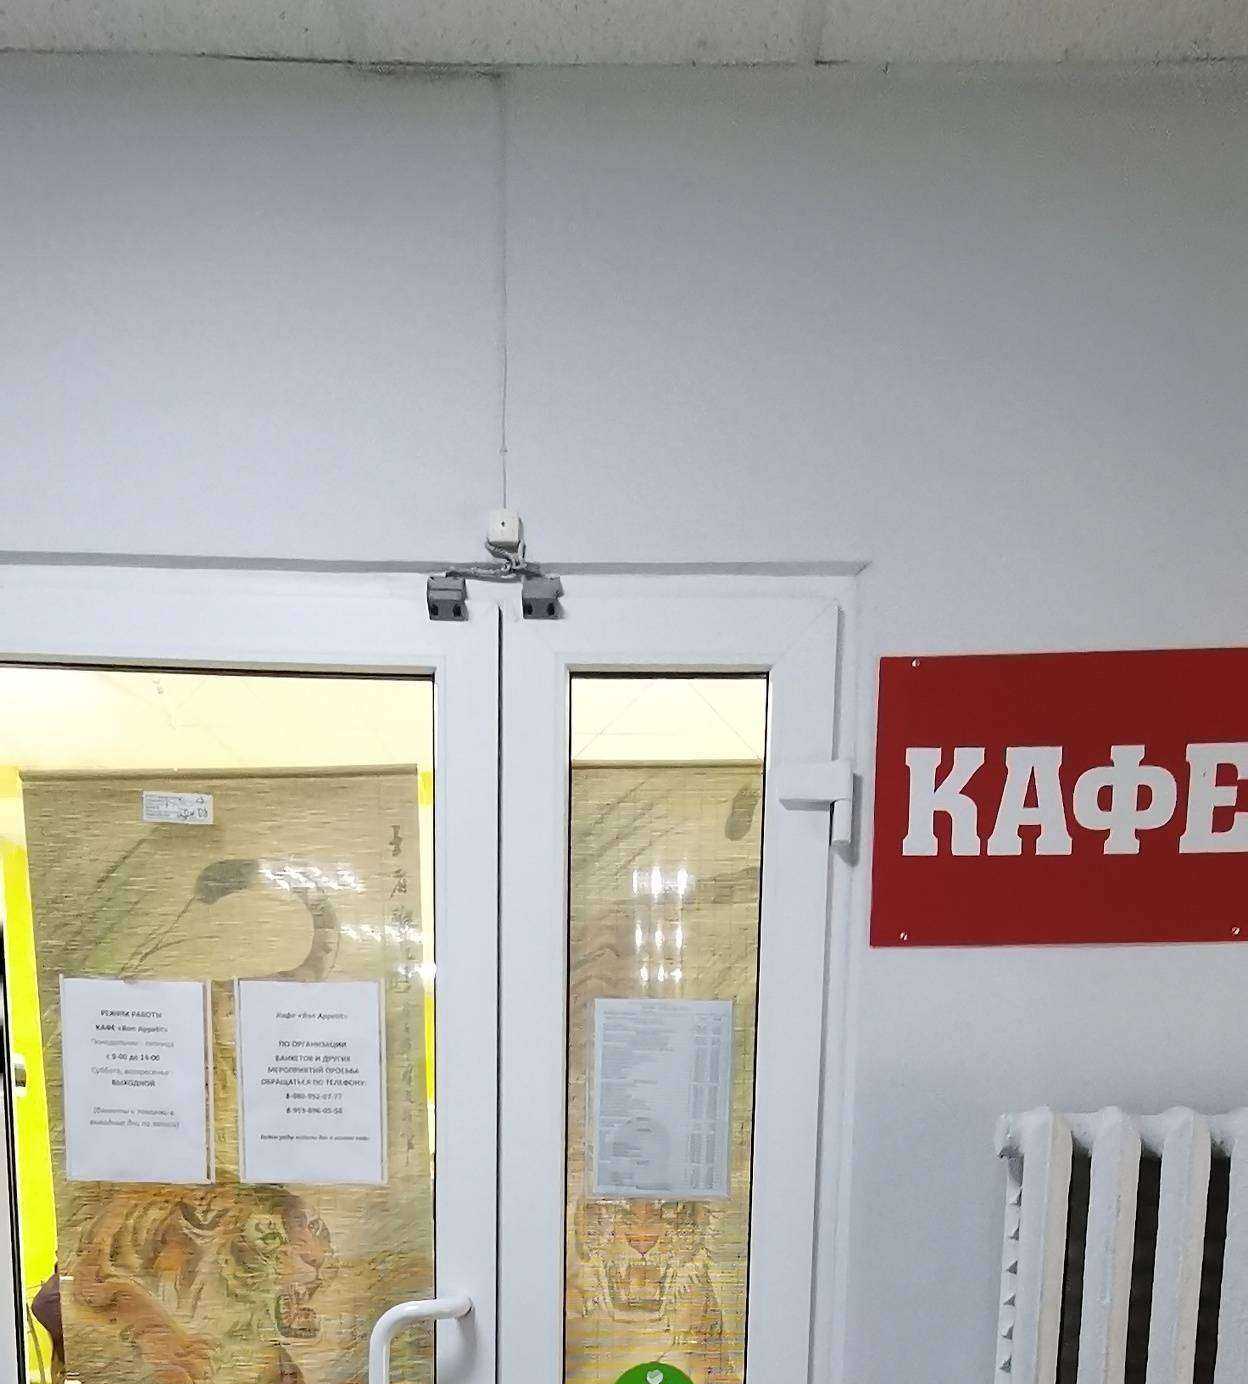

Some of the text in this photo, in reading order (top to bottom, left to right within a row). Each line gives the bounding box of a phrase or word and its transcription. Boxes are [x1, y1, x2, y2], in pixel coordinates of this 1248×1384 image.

[902, 741, 1248, 857] КАФЕ
[131, 1010, 163, 1019] РАБОТЫ
[95, 1024, 115, 1032] КАФЕ
[278, 1040, 347, 1049] ПО ОРГАНИЗАЦИИ
[129, 1053, 139, 1062] до
[275, 1054, 351, 1064] БАНКЕТОВ И ДРУГИХ
[267, 1065, 324, 1074] МЕРОПРИЯТИЙ
[111, 1079, 155, 1088] ВЫХОДНОЙ
[261, 1078, 312, 1087] ОБРАЩАТЬСЯ
